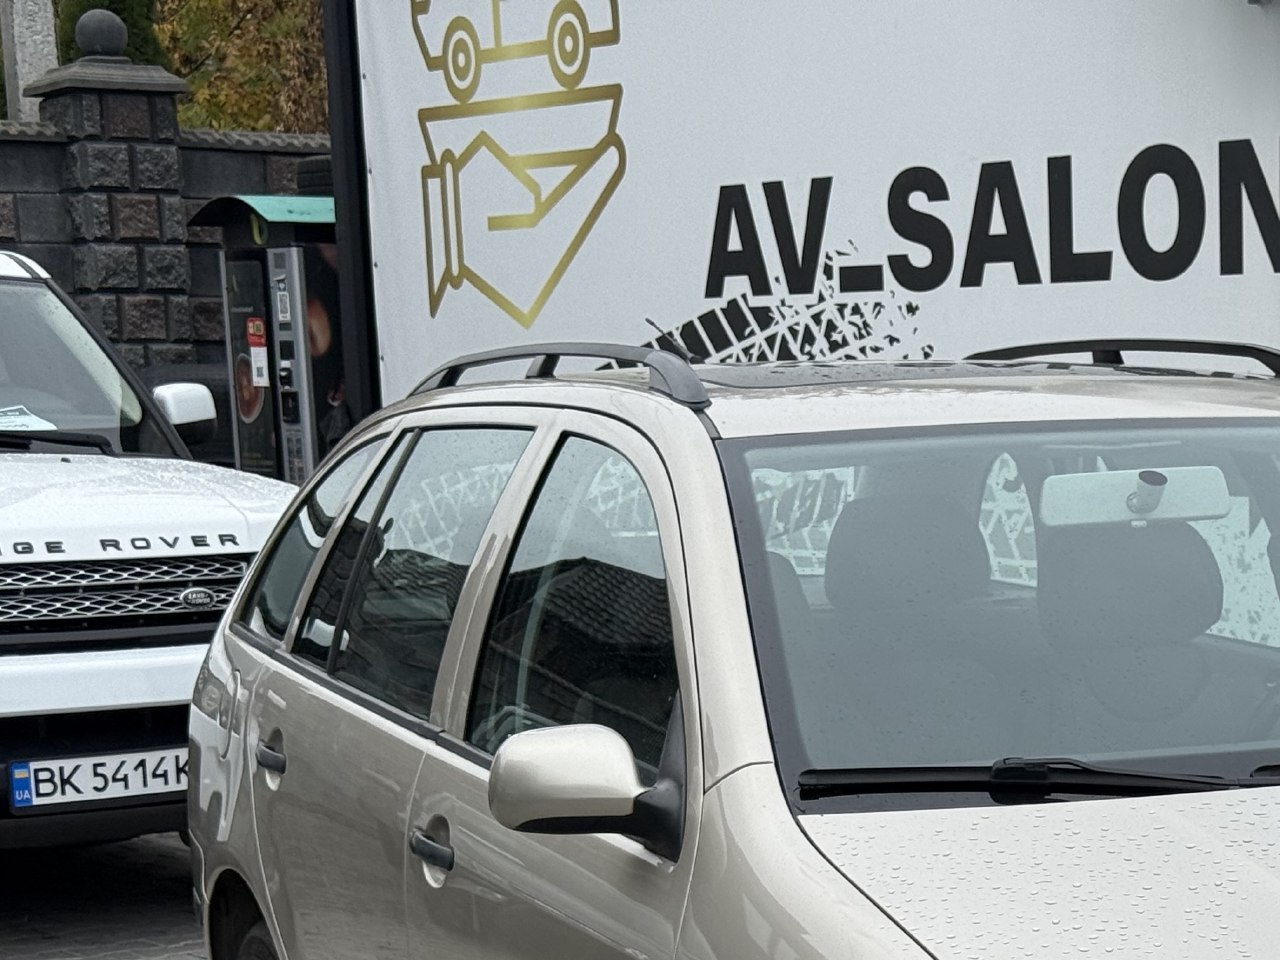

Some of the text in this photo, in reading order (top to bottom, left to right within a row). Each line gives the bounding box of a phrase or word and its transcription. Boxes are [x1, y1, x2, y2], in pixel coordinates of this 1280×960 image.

[0, 534, 240, 555] GE ROVER
[15, 789, 31, 801] UA
[33, 764, 84, 799] BK
